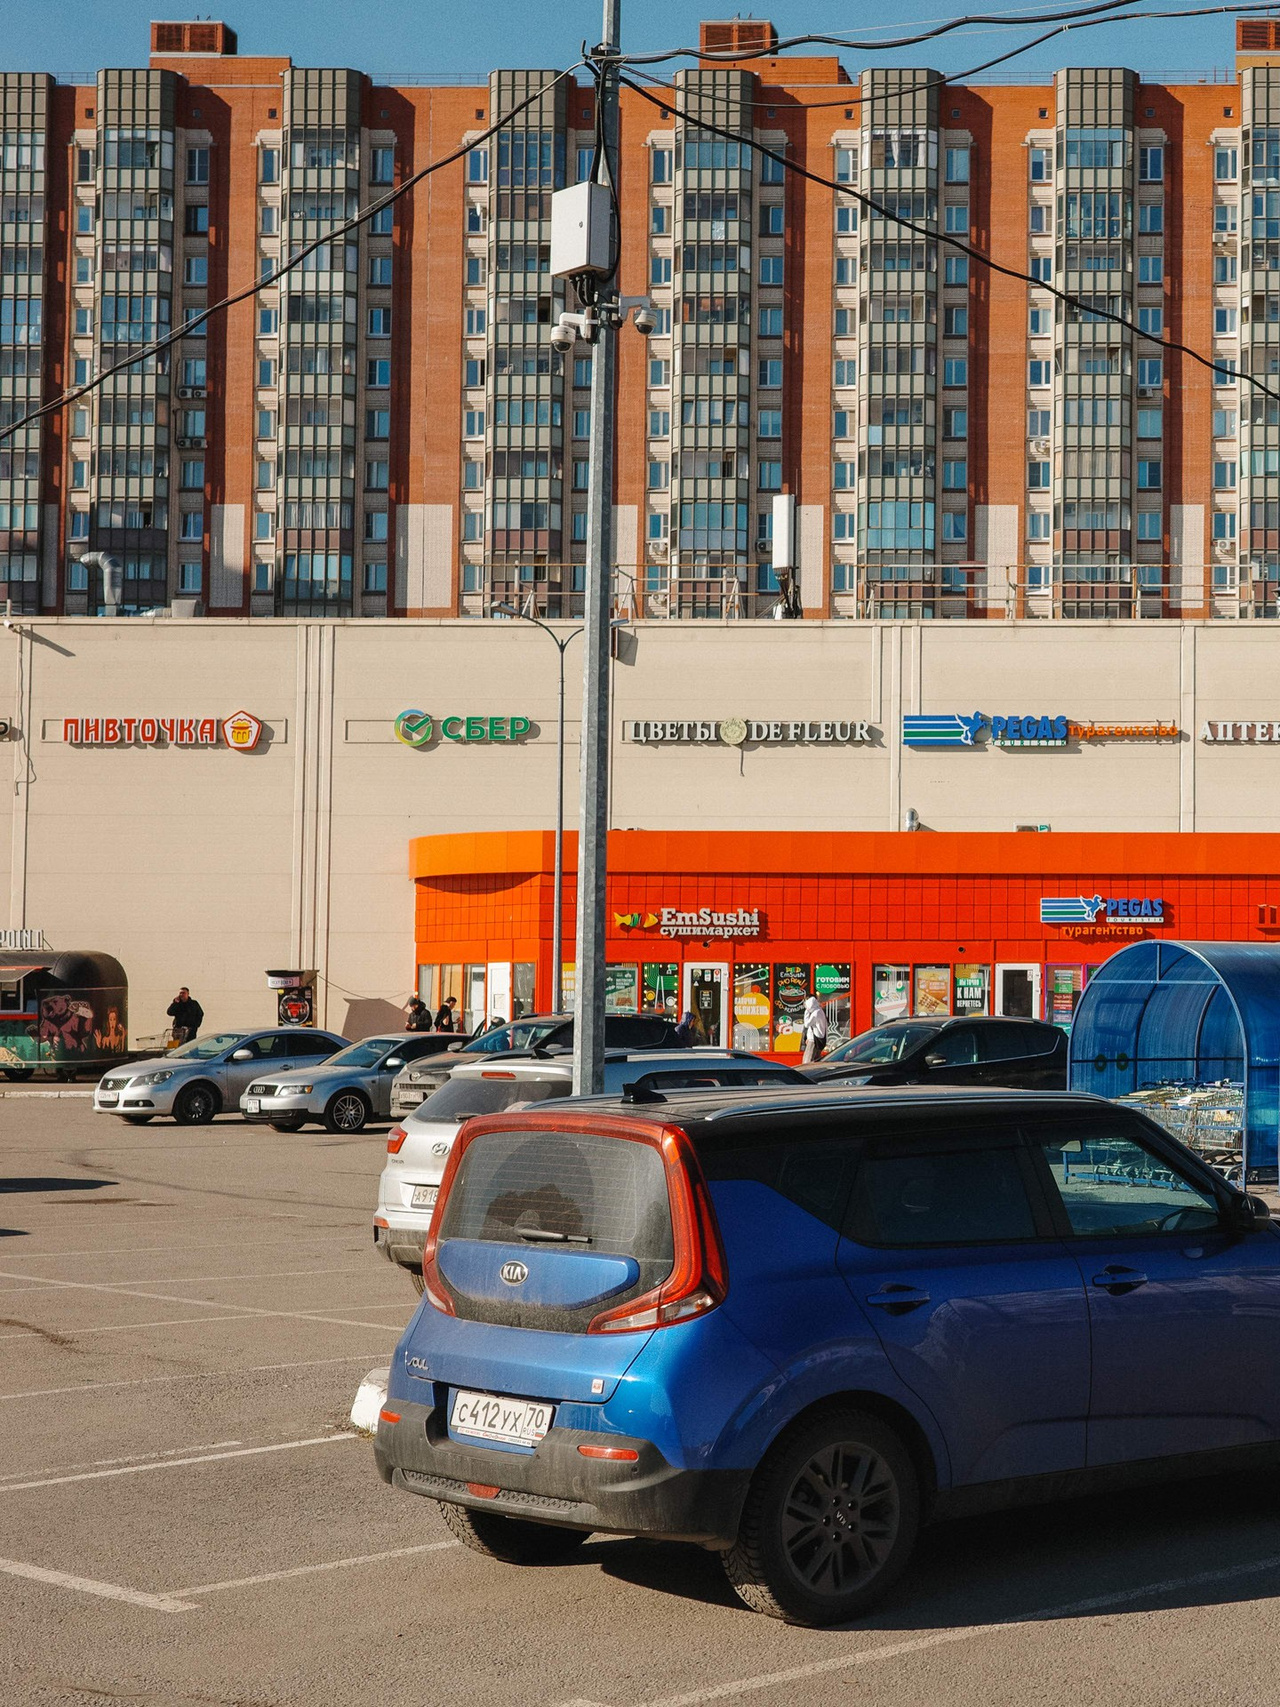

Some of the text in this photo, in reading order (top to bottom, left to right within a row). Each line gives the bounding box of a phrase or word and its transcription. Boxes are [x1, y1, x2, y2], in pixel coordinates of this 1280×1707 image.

[63, 718, 216, 743] ПИВТОЧКА
[441, 716, 531, 741] СБЕР
[630, 721, 871, 743] ЦВЕТЫ DE FLEUR
[992, 715, 1067, 739] PEGAS
[1069, 724, 1178, 739] турагентство
[1106, 899, 1163, 916] PEGAS
[660, 908, 759, 926] EmSushi
[660, 926, 760, 939] сушимаркет
[1062, 926, 1143, 937] турагентство
[956, 987, 982, 999] К НАМ
[503, 1265, 522, 1280] KIA
[458, 1400, 544, 1433] С412УХ 70
